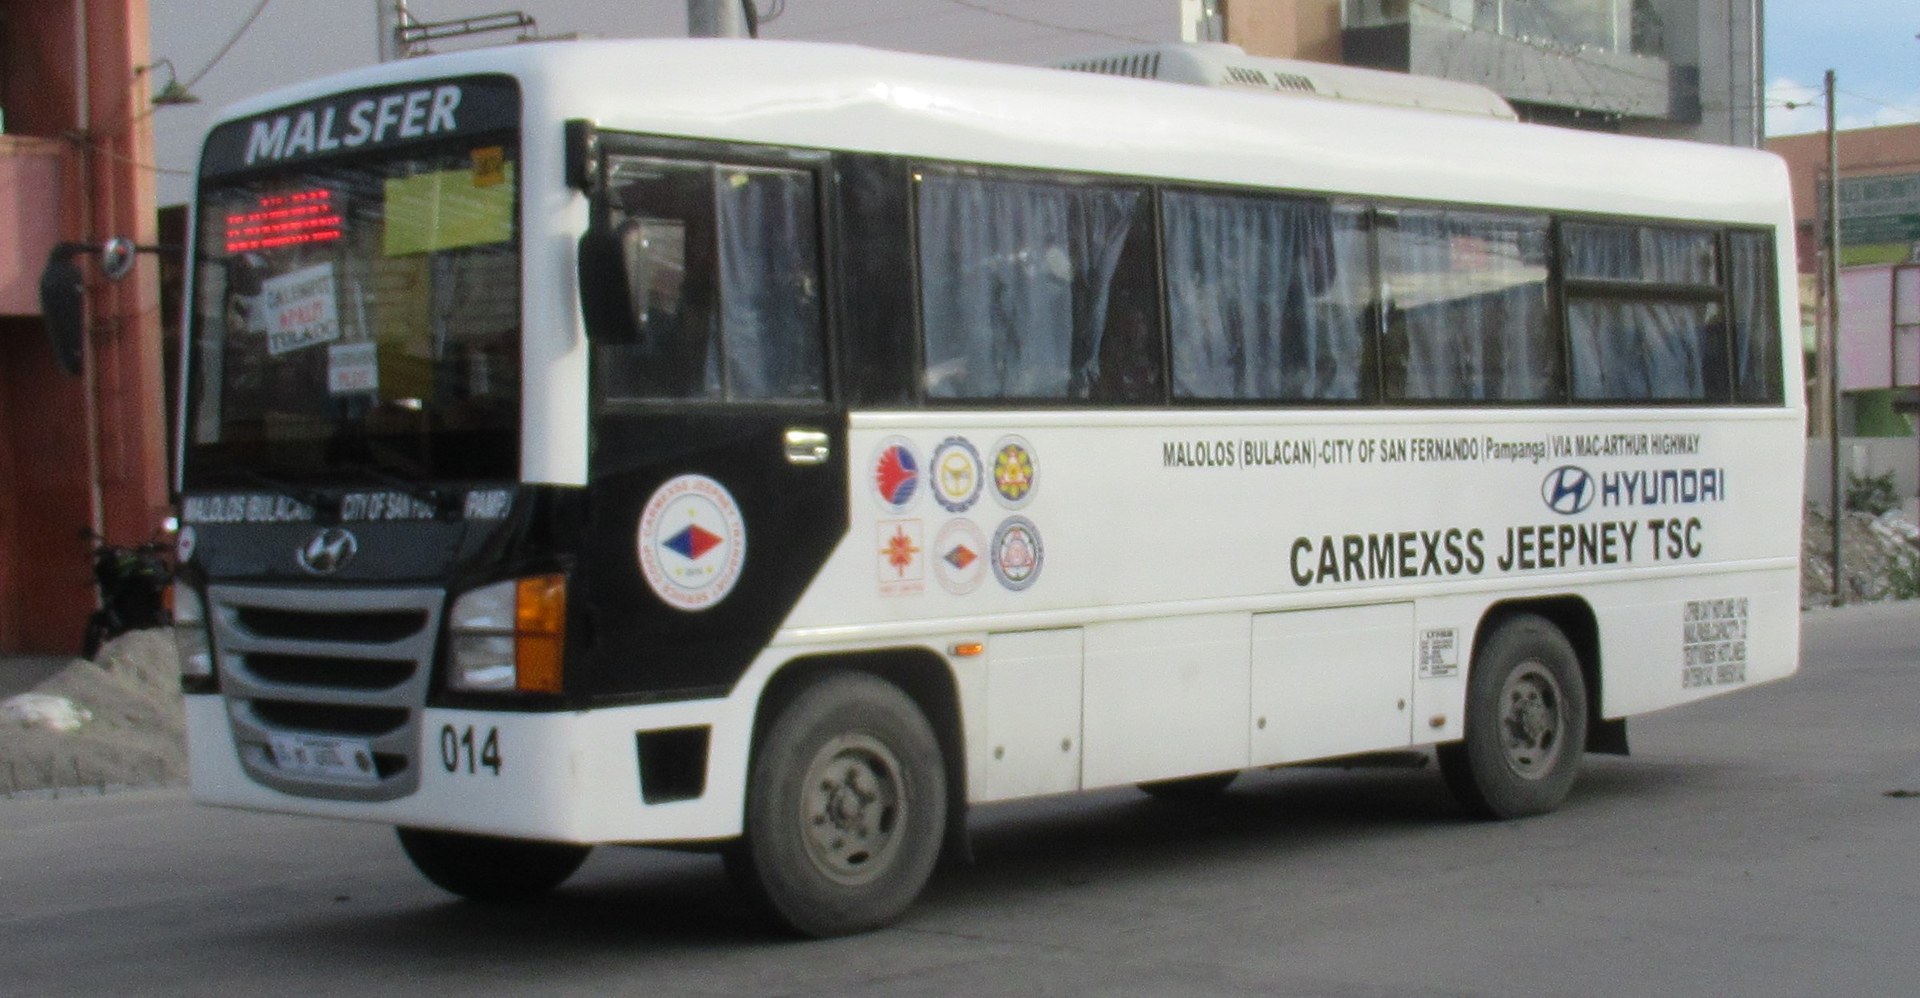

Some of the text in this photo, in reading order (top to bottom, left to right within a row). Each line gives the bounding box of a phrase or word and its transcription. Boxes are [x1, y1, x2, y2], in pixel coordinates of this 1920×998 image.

[244, 84, 462, 165] MALSFER
[1162, 440, 1236, 468] MALOLOS
[1358, 438, 1376, 464] OF
[1380, 438, 1406, 463] SAN
[1552, 434, 1572, 457] VIA
[1650, 432, 1701, 455] HIGHWAY
[1601, 468, 1725, 507] HYUNDAI
[1289, 516, 1703, 587] CARMEXSS JEEPNEY TSC
[439, 723, 503, 776] 014
